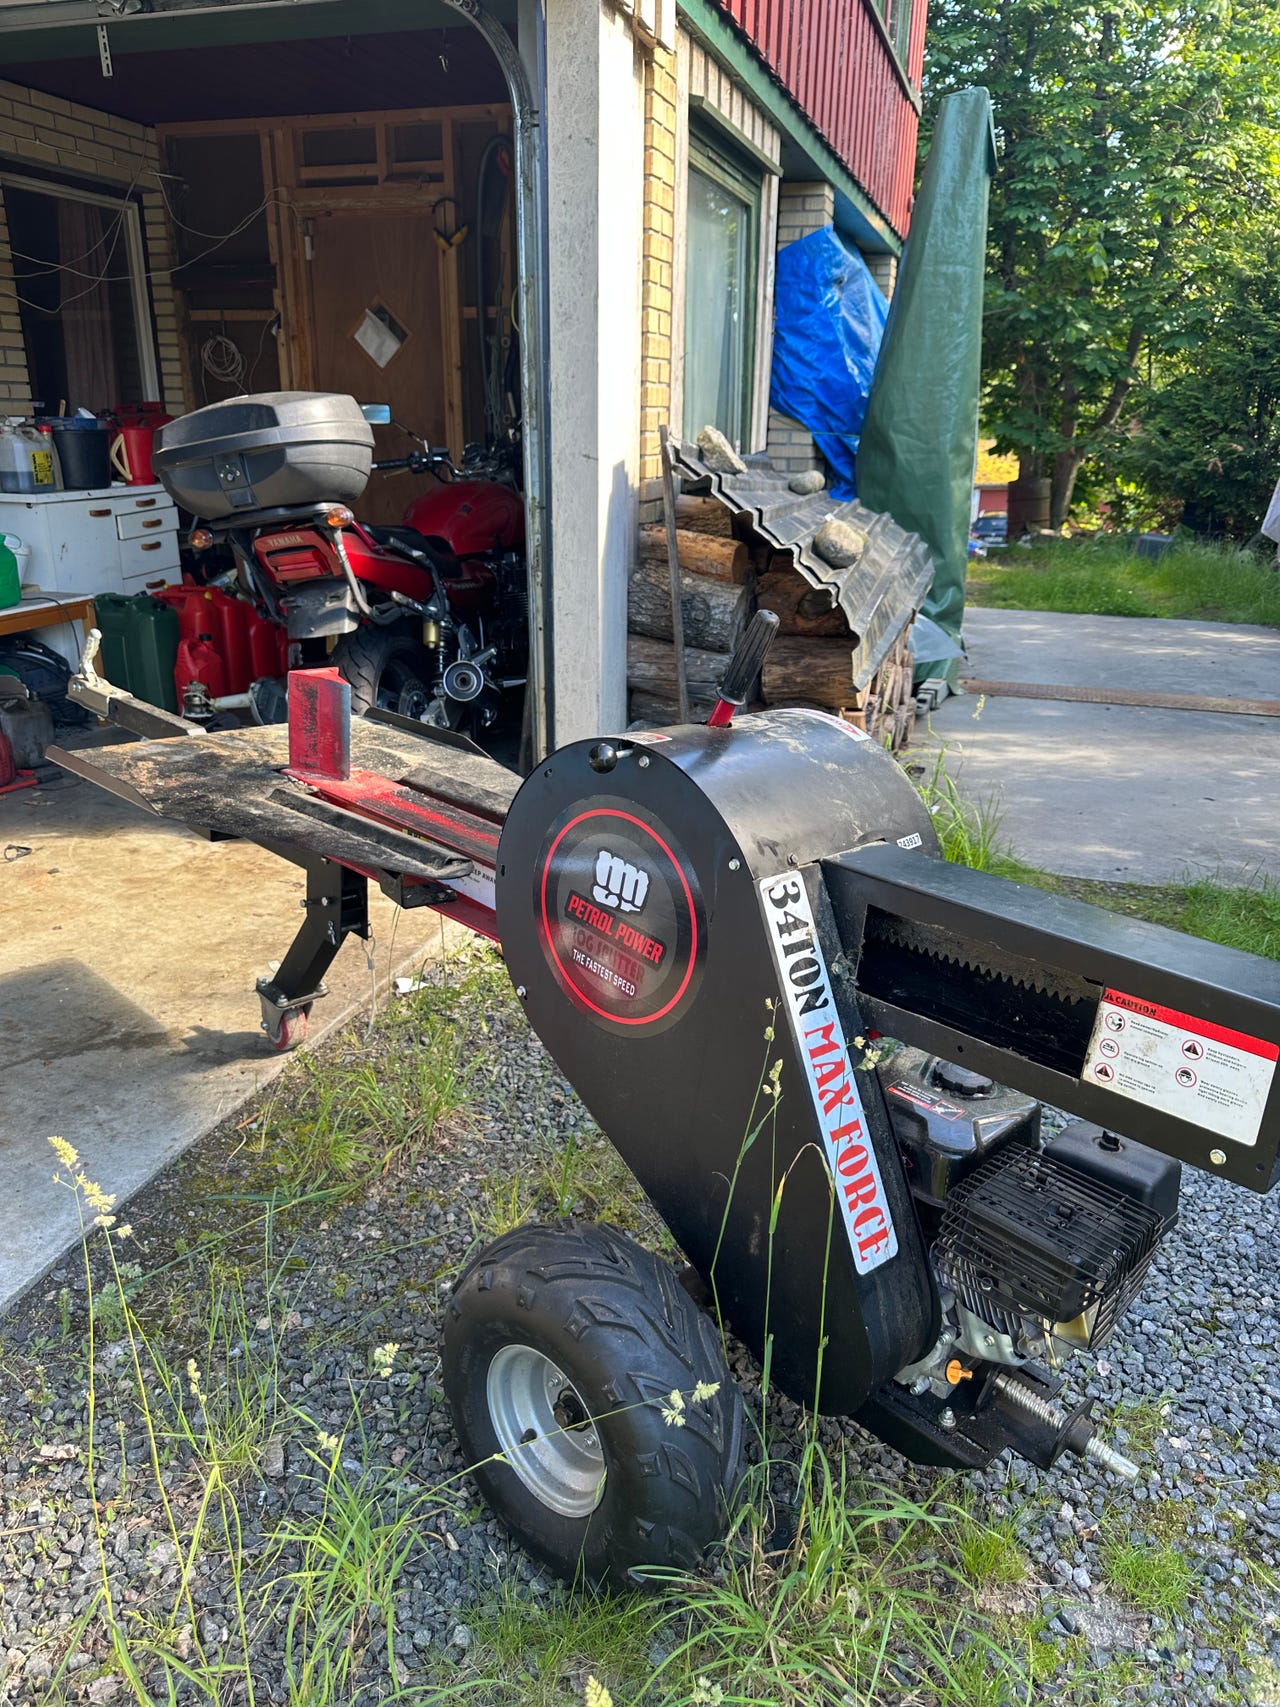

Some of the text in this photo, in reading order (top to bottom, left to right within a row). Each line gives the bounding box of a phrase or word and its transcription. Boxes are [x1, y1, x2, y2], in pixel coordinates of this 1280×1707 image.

[267, 535, 303, 546] YAMAHA
[568, 895, 664, 963] PETROL POWER
[572, 948, 636, 997] THE FASTEST SPEED
[1115, 996, 1157, 1016] CAUTION
[804, 1021, 854, 1117] MAX
[830, 1127, 890, 1263] FORCE
